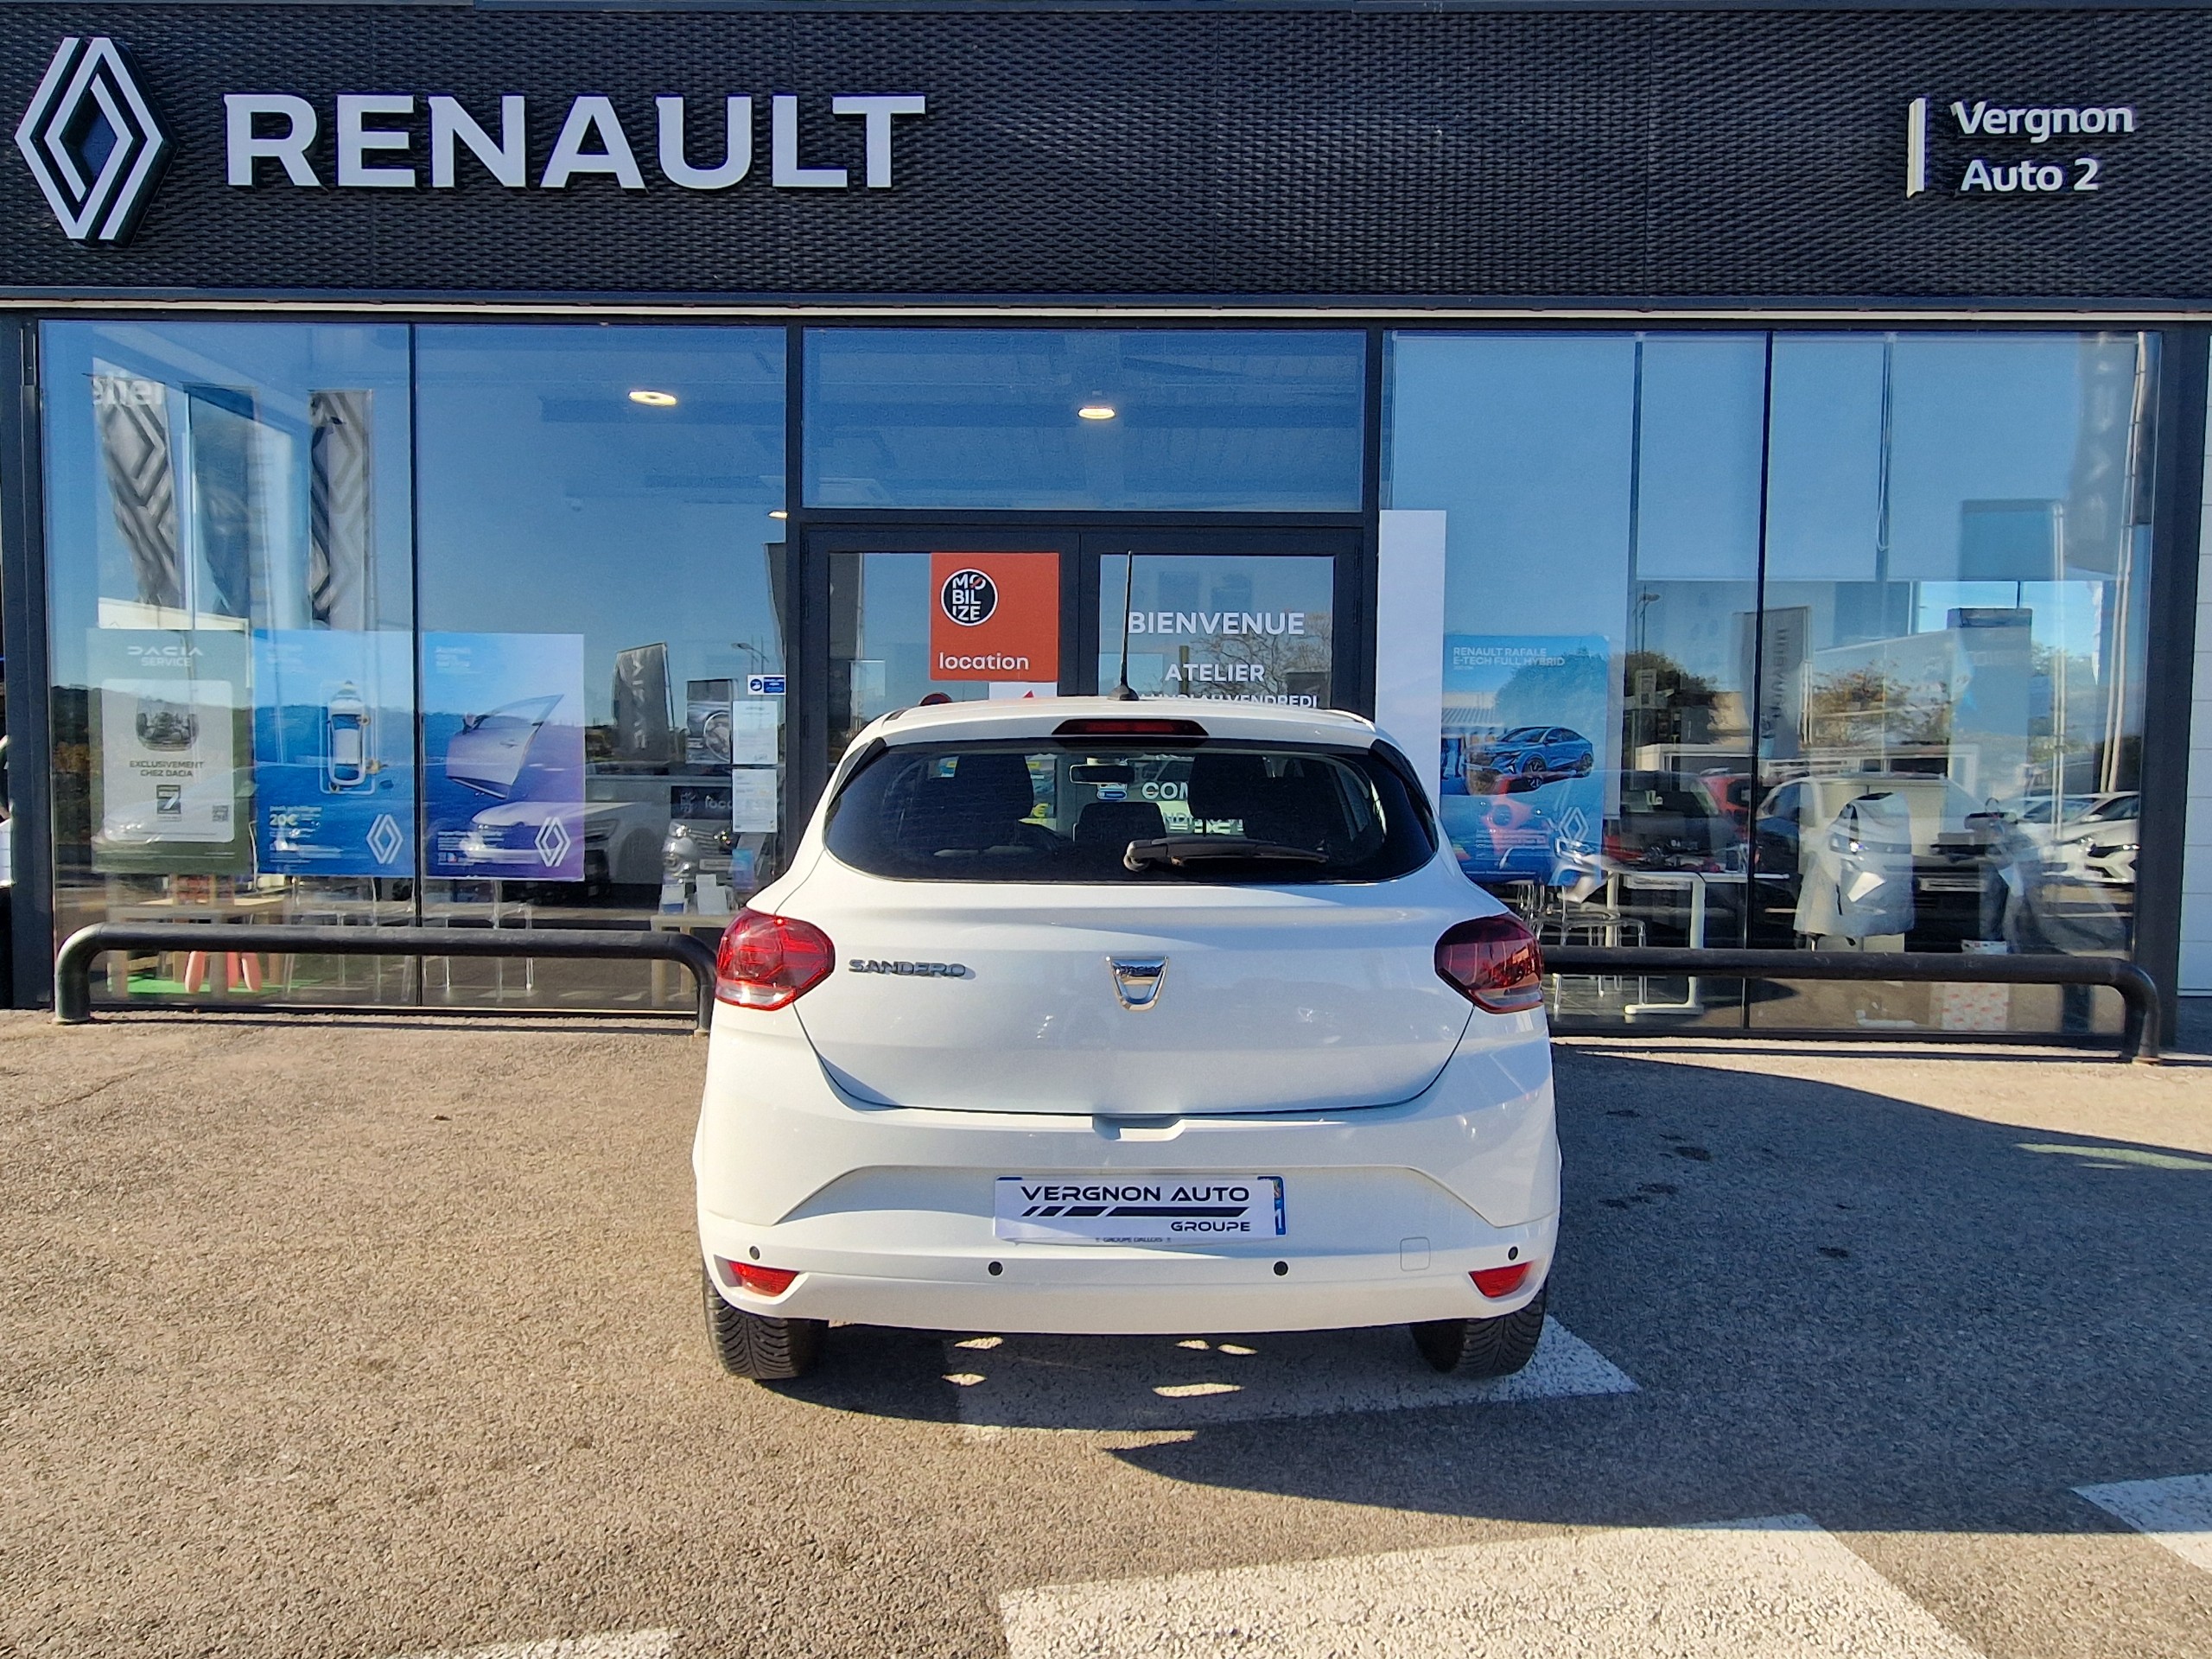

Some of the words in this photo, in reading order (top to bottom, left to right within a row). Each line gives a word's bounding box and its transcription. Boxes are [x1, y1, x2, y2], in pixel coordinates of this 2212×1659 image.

[1949, 100, 2136, 143] Vergnon
[223, 93, 925, 189] RENAULT
[1960, 159, 2063, 191] Auto
[2074, 157, 2099, 191] 2
[952, 589, 982, 604] BIL
[952, 605, 981, 621] IZE
[1128, 612, 1306, 635] BIENVENUE
[126, 645, 204, 656] DACIA
[1452, 647, 1503, 657] RENAULT
[1504, 647, 1547, 657] RAFALE
[140, 657, 191, 667] SERVICE
[938, 652, 1030, 671] location
[1452, 657, 1492, 665] E-TECH
[1493, 657, 1522, 666] FULL
[1523, 657, 1566, 666] HYBRID
[1165, 663, 1266, 683] ATELIER
[848, 958, 968, 978] SANDERO
[1020, 1185, 1161, 1202] VERGNON
[1169, 1185, 1250, 1202] AUTO
[1170, 1220, 1251, 1232] GROUPE
